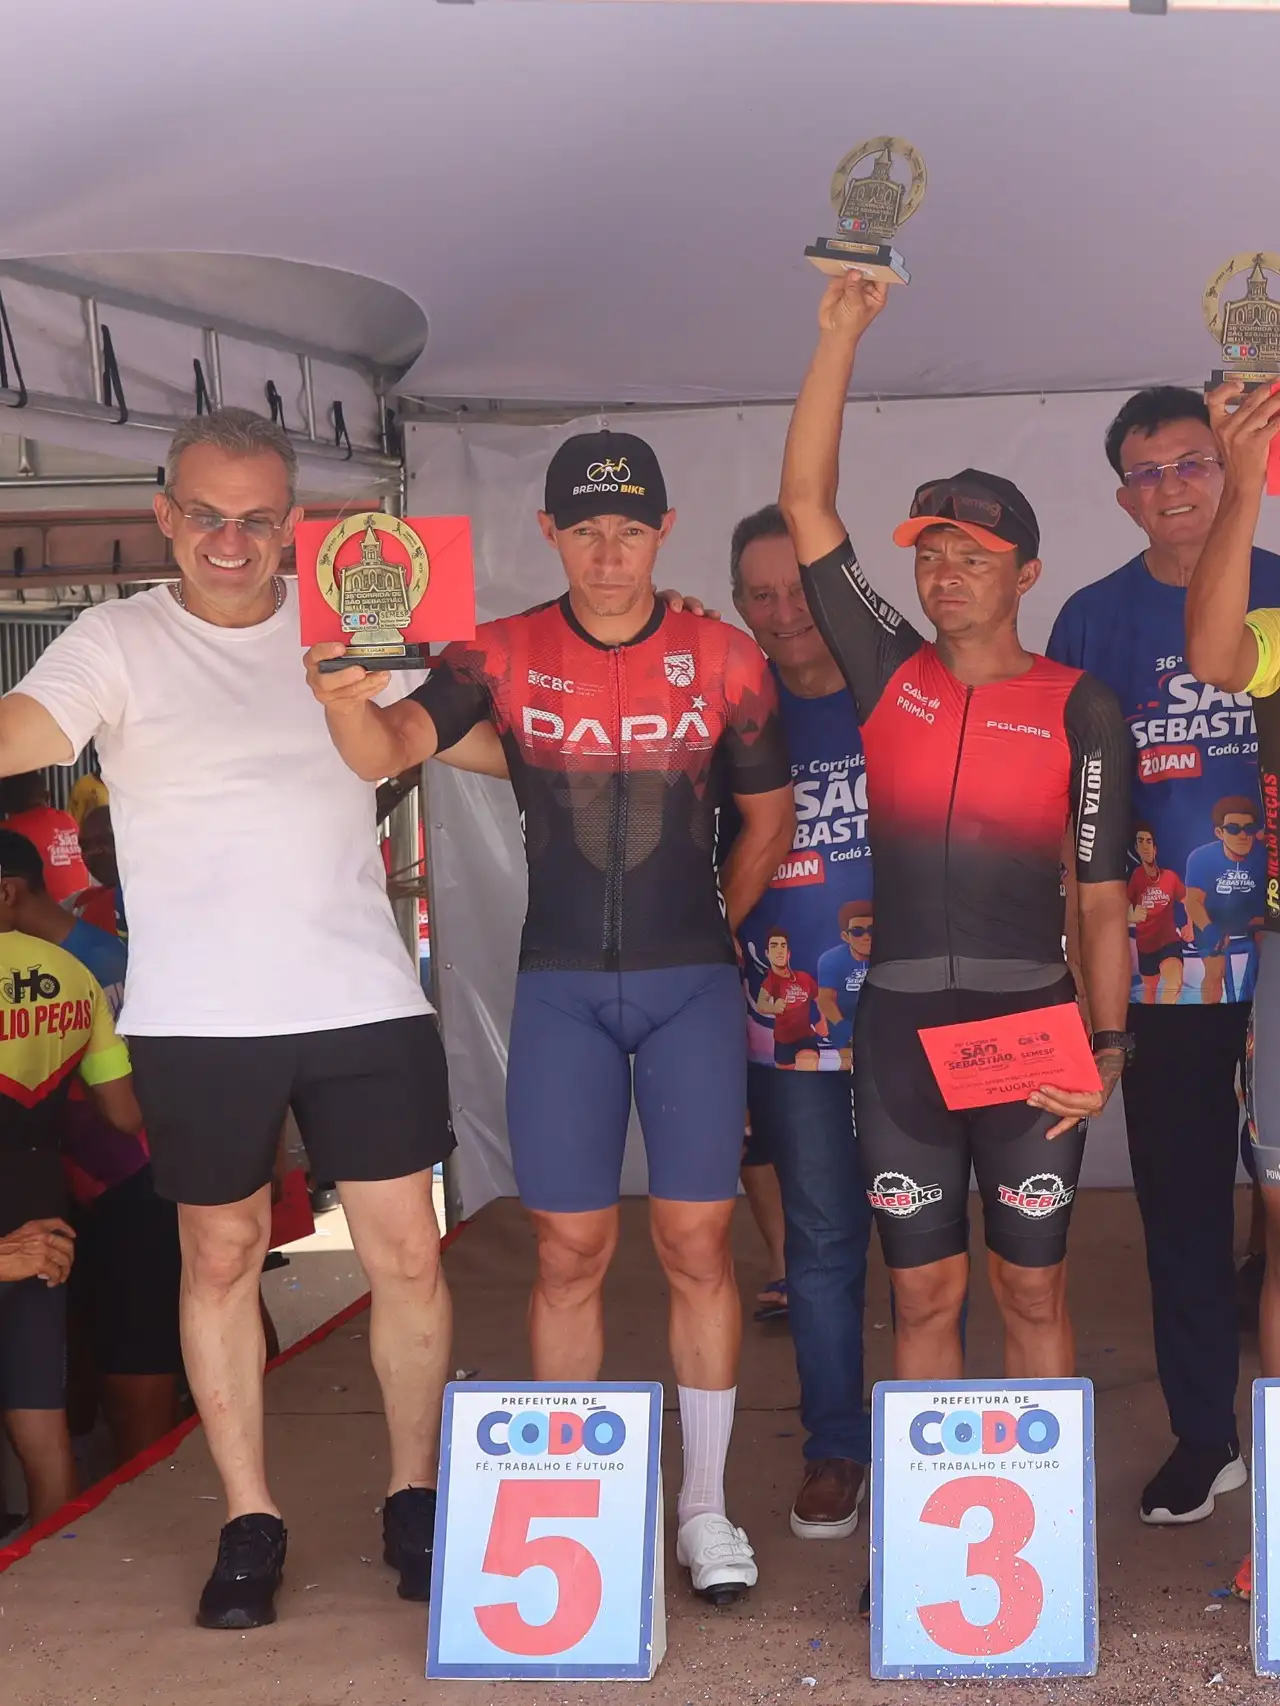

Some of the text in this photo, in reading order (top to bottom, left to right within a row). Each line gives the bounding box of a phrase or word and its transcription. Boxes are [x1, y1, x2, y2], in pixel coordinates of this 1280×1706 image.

[572, 483, 646, 496] BRENDO BIKE
[1155, 656, 1183, 672] 36ª
[897, 695, 936, 725] PRIMAQ
[986, 720, 1051, 739] POLARIS
[1130, 709, 1257, 749] SEBASTI
[1207, 742, 1259, 757] Codó 20
[1141, 752, 1196, 777] 20JAN
[1083, 759, 1102, 815] ROTA
[792, 813, 869, 850] BAST
[829, 847, 862, 862] Codó
[0, 1000, 92, 1041] LIO PEÇAS
[948, 1053, 1014, 1070] SEBASTIÃO
[961, 1043, 999, 1060] SÃO
[999, 1081, 1036, 1093] LUGAR
[866, 1188, 943, 1209] TeleBike
[998, 1186, 1075, 1210] TeleBike
[501, 1397, 598, 1405] PREFEITURA DE
[933, 1395, 1029, 1405] PREFEITURA DE
[476, 1405, 627, 1456] CODÓ
[909, 1404, 1060, 1456] CODÓ
[475, 1459, 625, 1472] FÉ, TRABALHO E FUTURO
[910, 1460, 1060, 1472] FÉ, TRABALHO E FUTURO
[474, 1479, 602, 1656] 5
[916, 1475, 1043, 1656] 3
